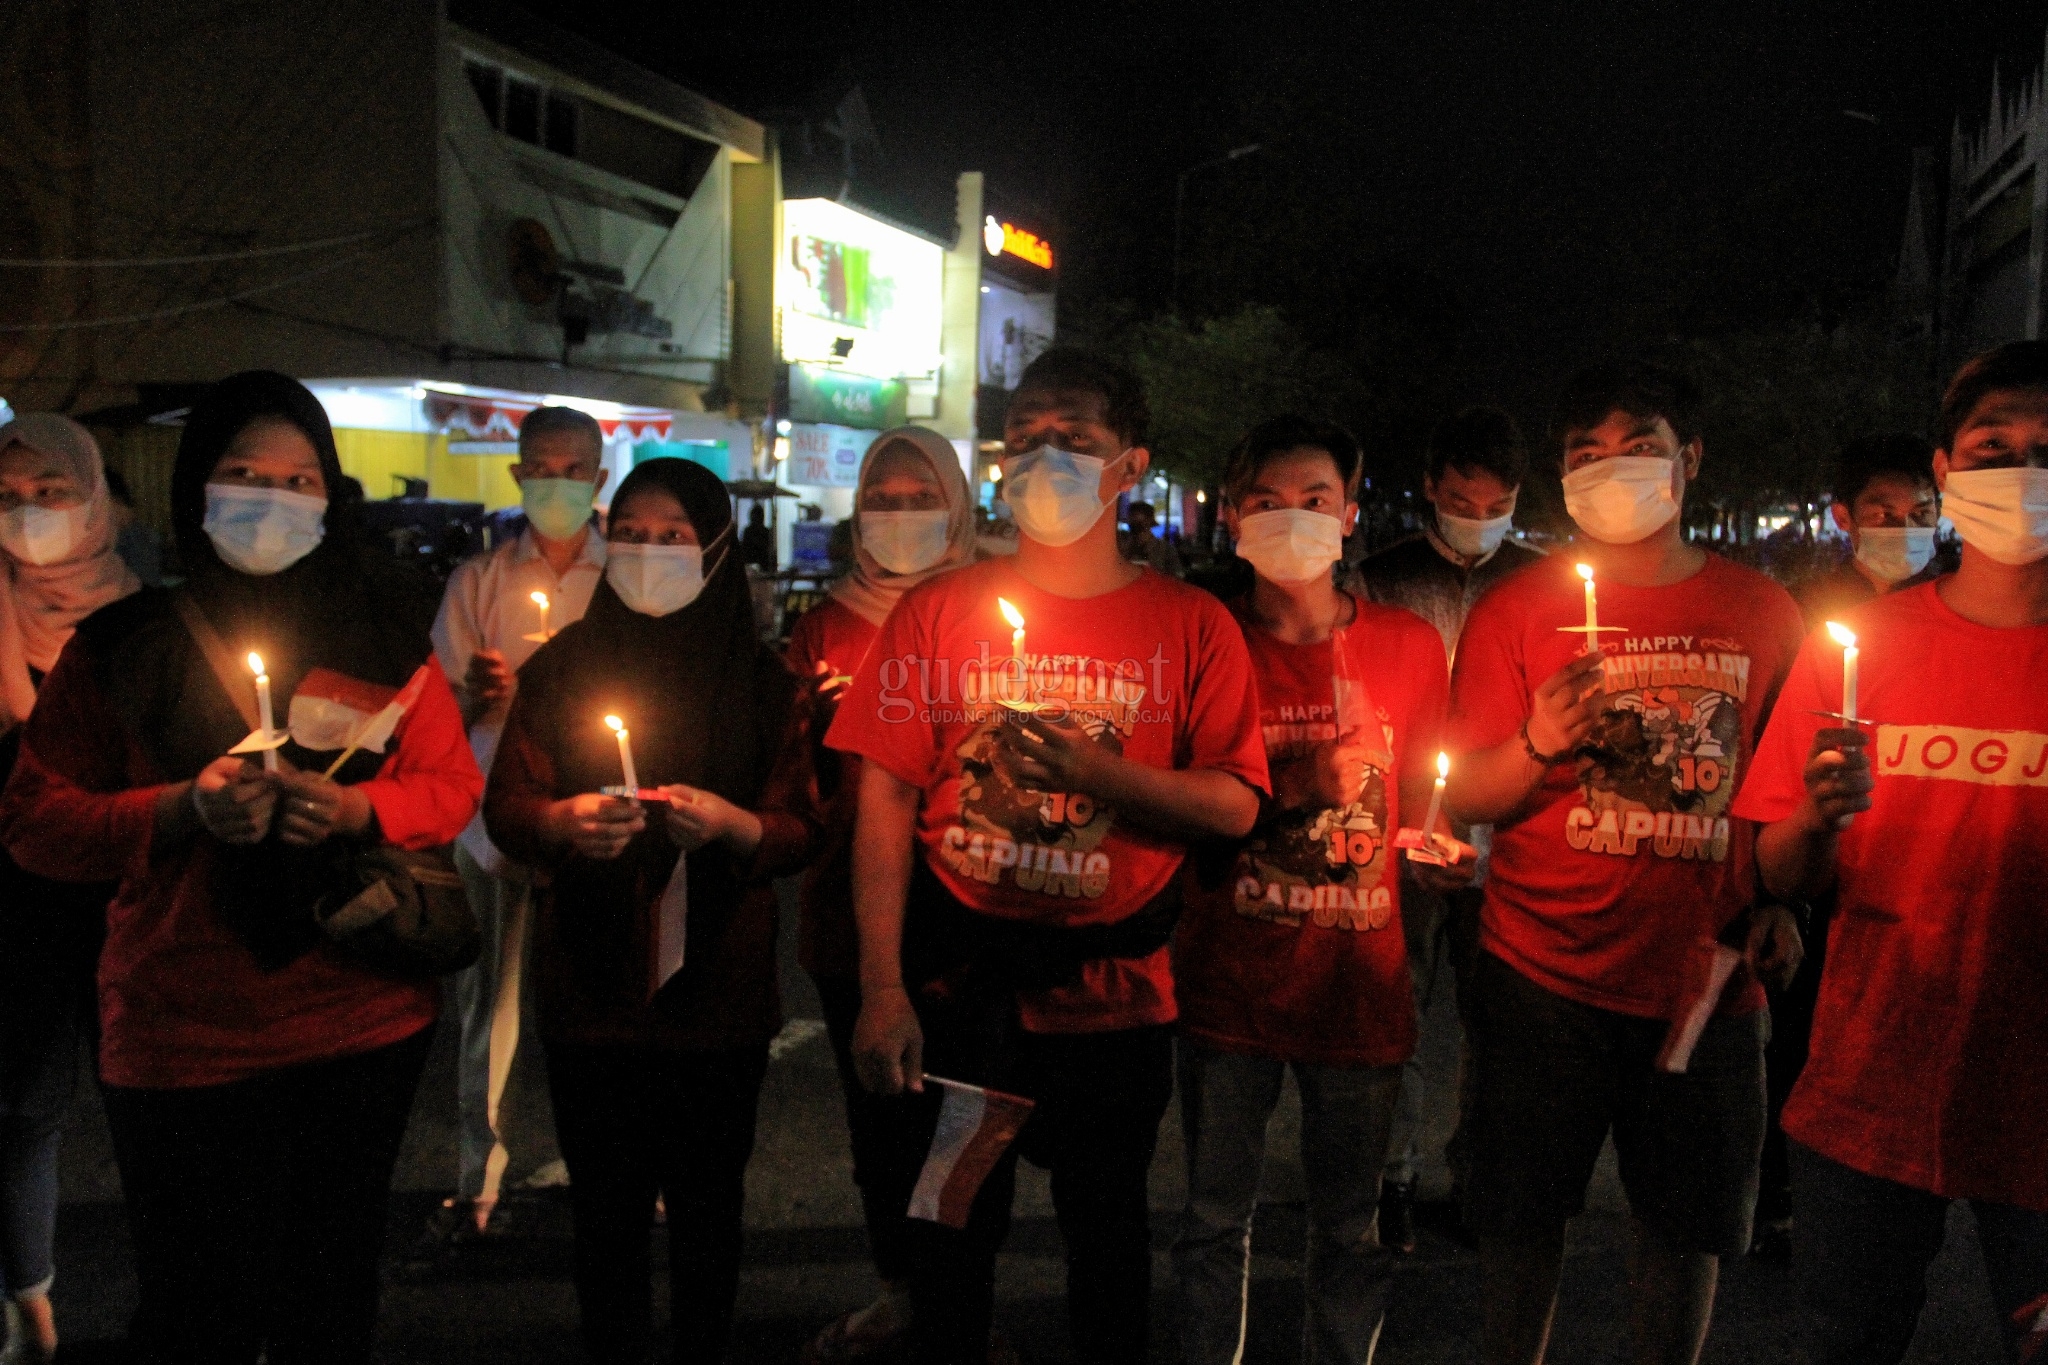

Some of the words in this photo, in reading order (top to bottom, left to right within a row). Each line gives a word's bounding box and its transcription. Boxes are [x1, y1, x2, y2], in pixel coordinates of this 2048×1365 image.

[1624, 636, 1695, 652] HAPPY
[1604, 652, 1750, 704] NIVERSARY
[1280, 705, 1334, 721] HAPP
[1885, 733, 2048, 779] JOGJ
[1565, 806, 1730, 863] CAPUNG
[939, 826, 1111, 899] CAPUNG
